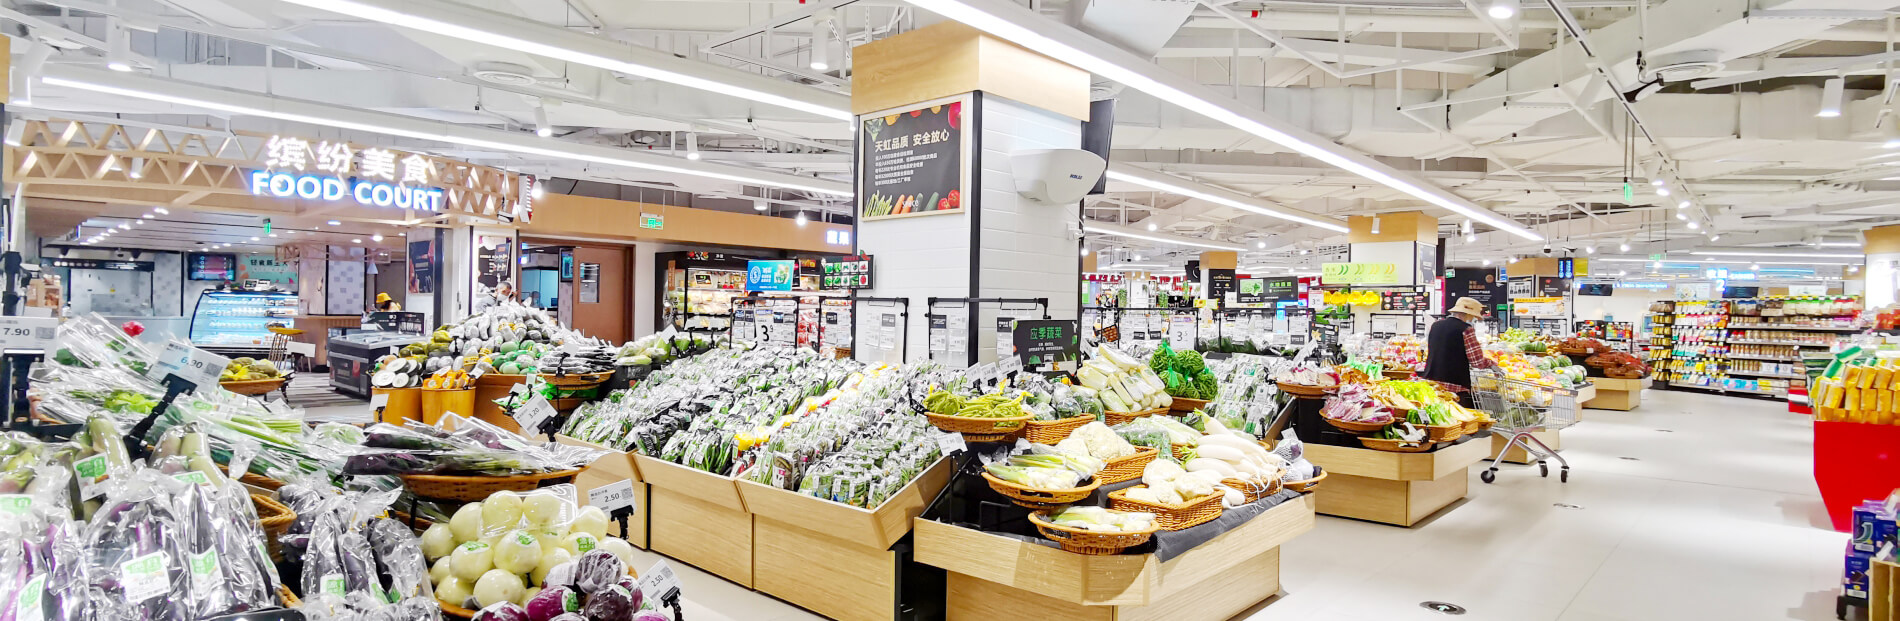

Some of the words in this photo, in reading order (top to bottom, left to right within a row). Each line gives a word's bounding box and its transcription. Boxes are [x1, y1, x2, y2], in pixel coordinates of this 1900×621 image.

[874, 135, 909, 152] 天虹品质
[912, 128, 950, 147] 安全放心
[265, 134, 430, 185] 缤纷美食
[252, 171, 345, 201] FOOD
[353, 181, 442, 212] COURT
[1715, 279, 1726, 293] 2
[3, 327, 30, 337] 7.90
[761, 324, 770, 342] 3
[1030, 326, 1062, 340] 应季蔬菜
[1176, 330, 1183, 342] 3
[604, 492, 620, 502] 2.50
[650, 574, 664, 587] 2.50
